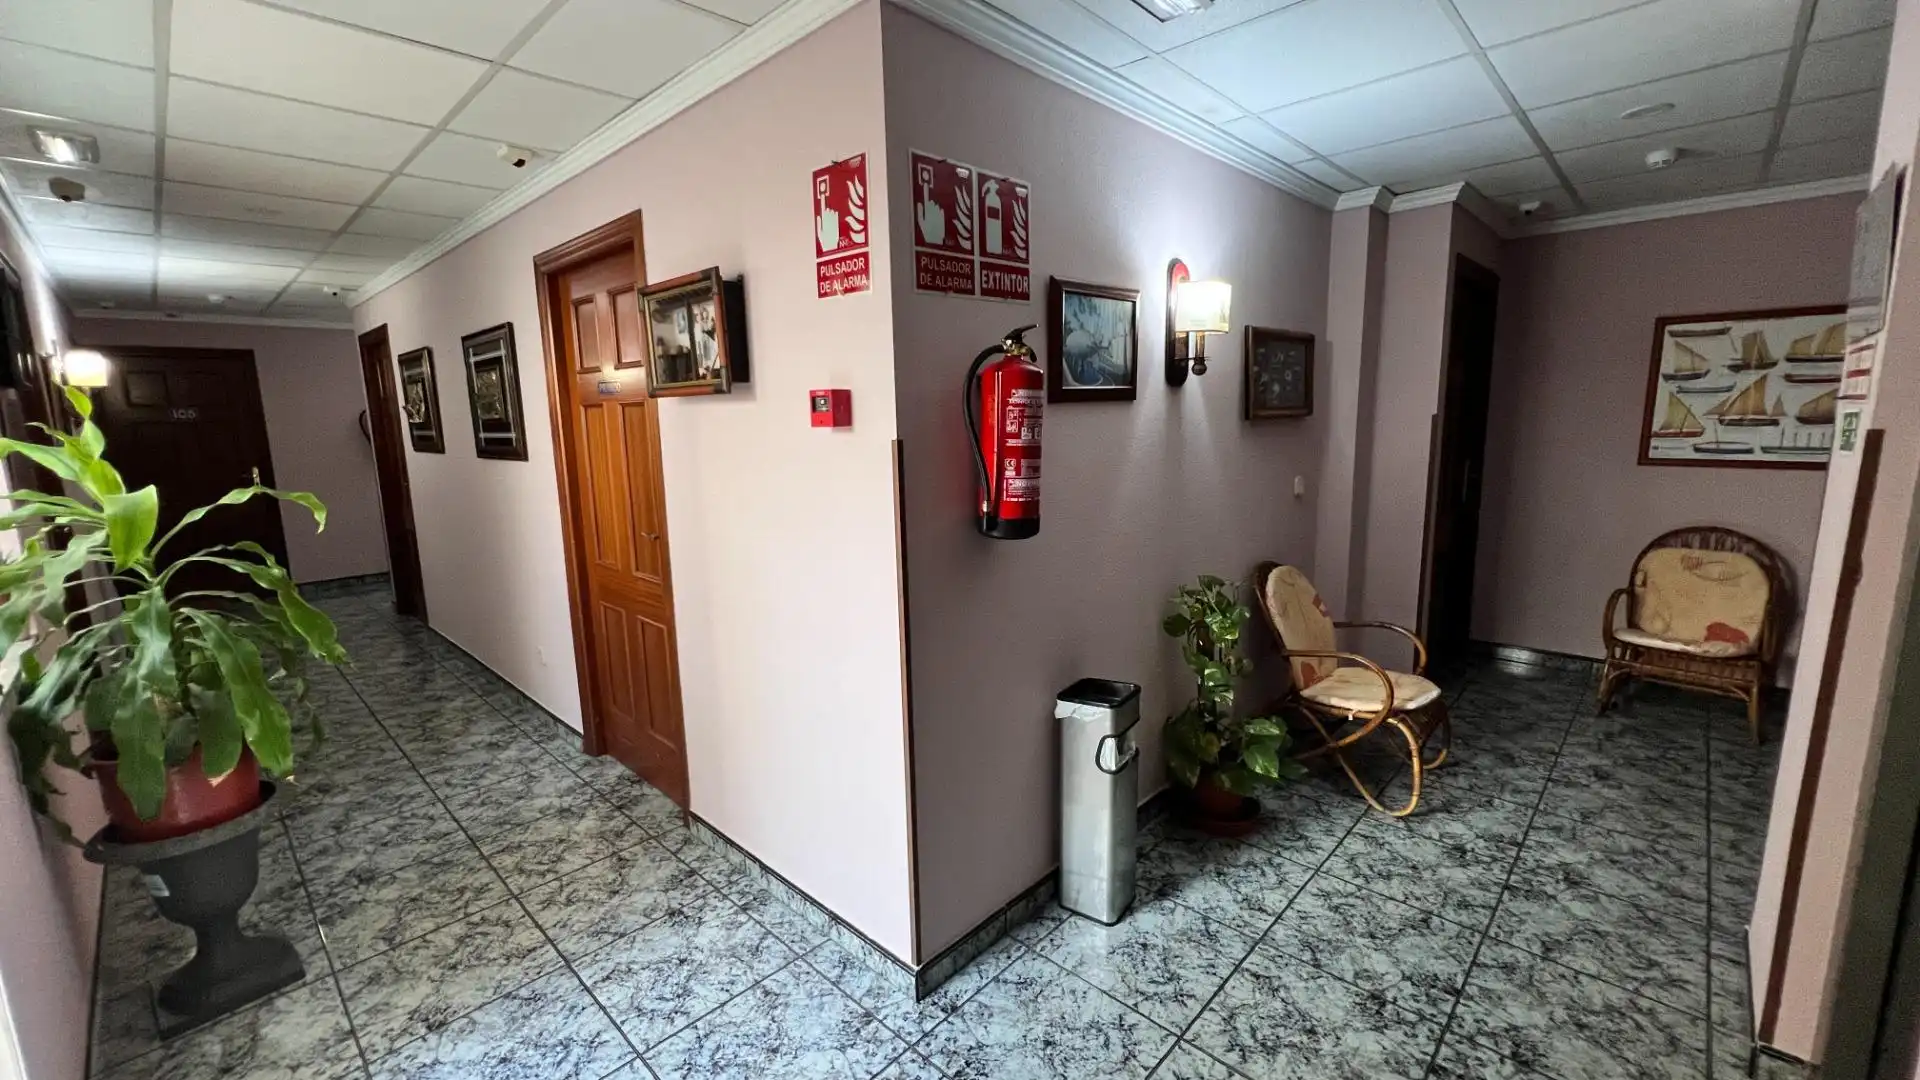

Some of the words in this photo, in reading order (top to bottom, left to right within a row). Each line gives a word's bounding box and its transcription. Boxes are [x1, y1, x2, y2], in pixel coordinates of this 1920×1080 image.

[820, 257, 866, 277] PULSADOR
[921, 256, 972, 275] PULSADOR
[820, 280, 831, 293] DE
[832, 274, 868, 292] ALARMA
[920, 272, 933, 286] DE
[935, 275, 973, 290] ALARMA
[982, 269, 1029, 293] EXTINTOR
